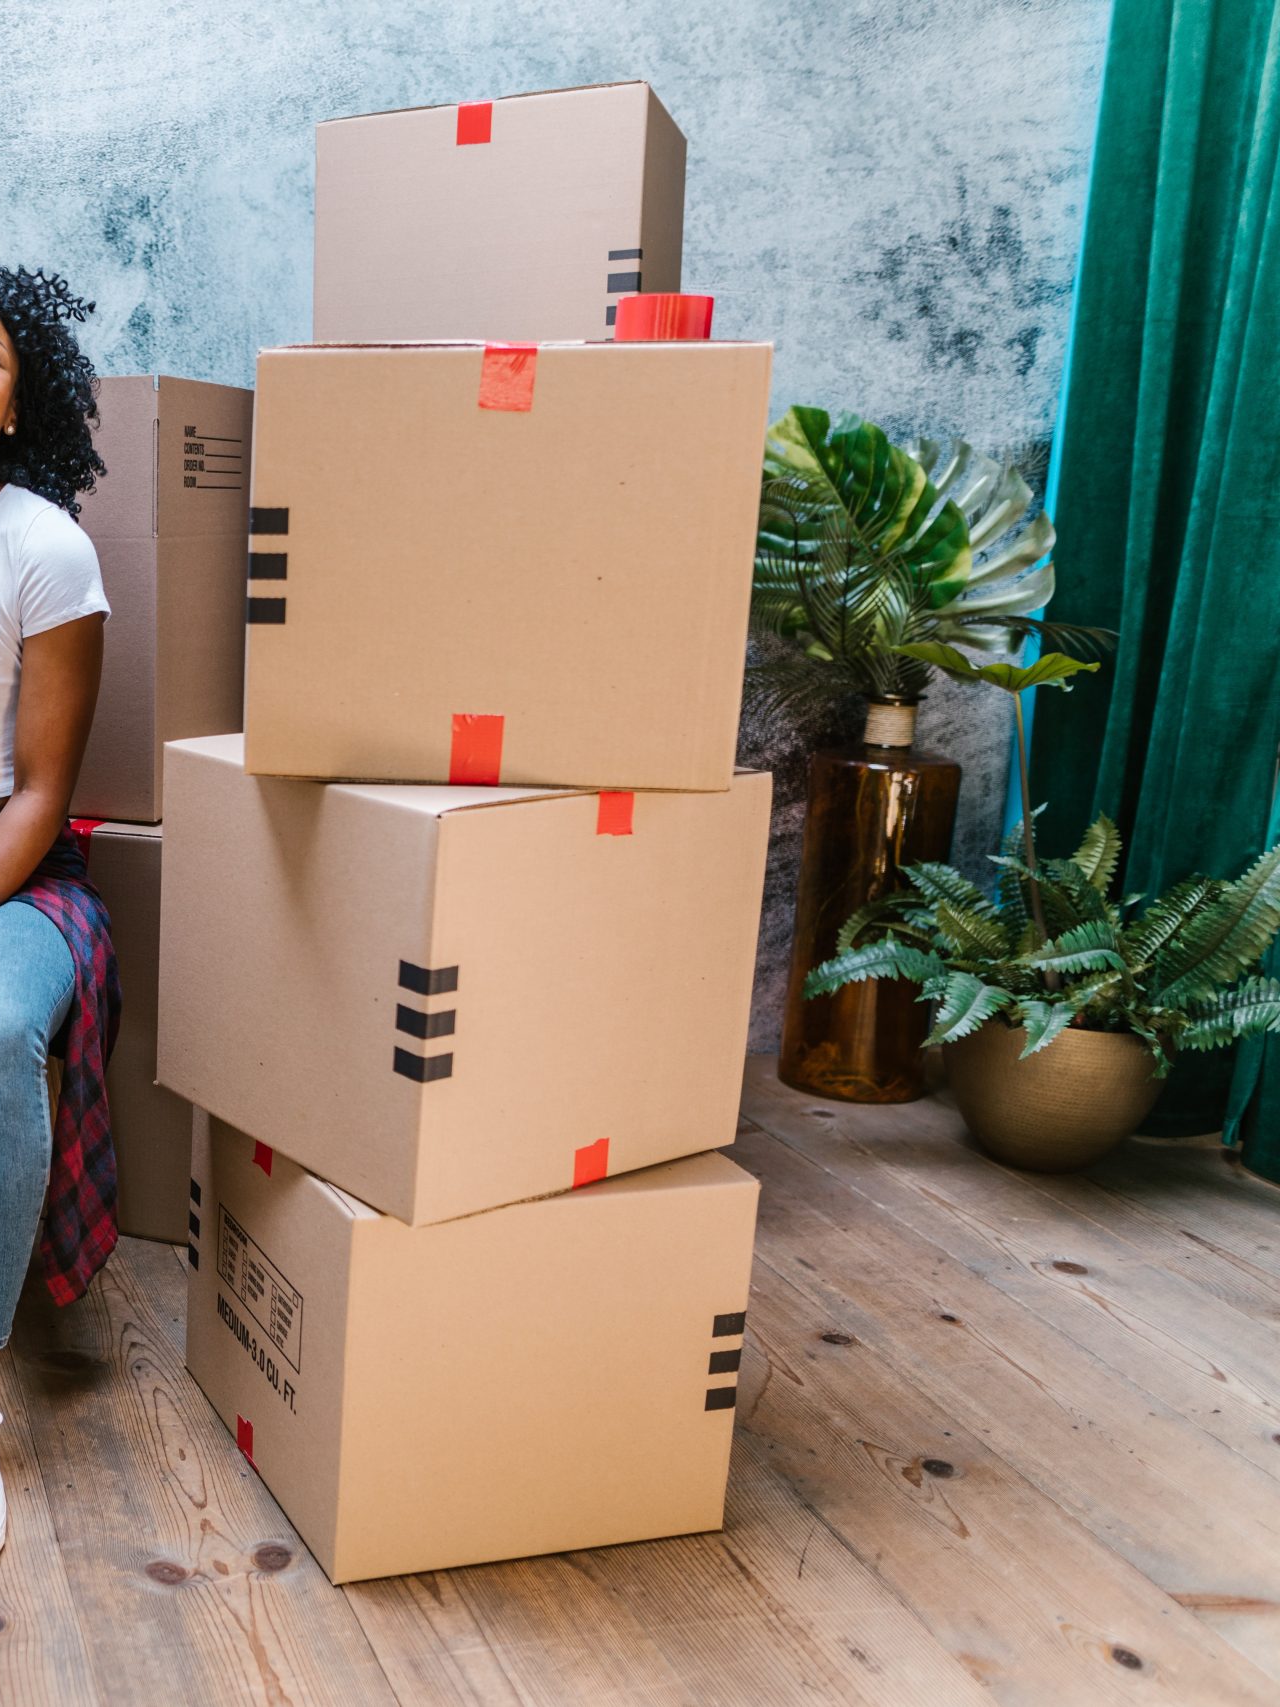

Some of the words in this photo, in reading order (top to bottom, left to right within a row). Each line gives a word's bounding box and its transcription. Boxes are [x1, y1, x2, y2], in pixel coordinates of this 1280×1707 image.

[183, 442, 205, 455] CONTENTS
[224, 1213, 248, 1248] BEDROOM
[217, 1292, 266, 1373] MEDIUM-3.0
[266, 1357, 281, 1395] CU.
[283, 1379, 297, 1416] FT.
